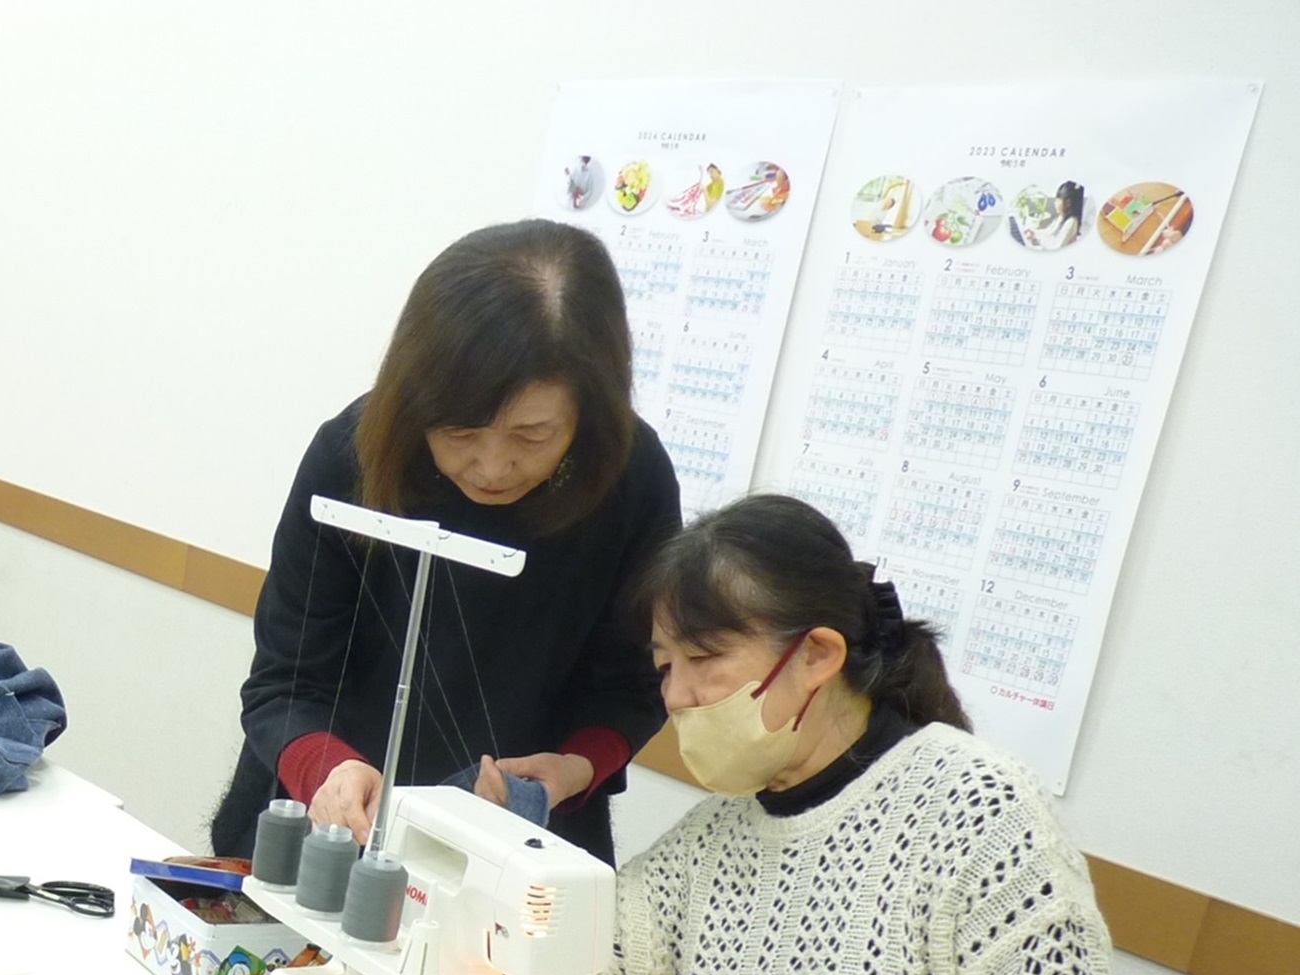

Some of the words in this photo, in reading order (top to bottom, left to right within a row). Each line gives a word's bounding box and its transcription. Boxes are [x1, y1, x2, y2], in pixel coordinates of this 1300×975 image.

[661, 132, 706, 141] CALENDAR
[969, 146, 996, 156] 2023
[1000, 147, 1066, 157] CALENDAR
[702, 231, 709, 242] 3
[944, 258, 952, 271] 2
[985, 264, 1031, 277] February
[1066, 266, 1075, 280] 3
[1126, 275, 1163, 287] March
[821, 349, 830, 360] 4
[922, 361, 931, 374] 5
[985, 373, 1007, 385] May
[1038, 375, 1047, 388] 6
[1104, 386, 1130, 399] June
[802, 443, 810, 454] 7
[901, 460, 909, 472] 8
[948, 472, 982, 485] August
[1013, 479, 1021, 492] 9
[1041, 487, 1100, 506] September
[980, 579, 995, 594] 12
[1014, 590, 1068, 610] December
